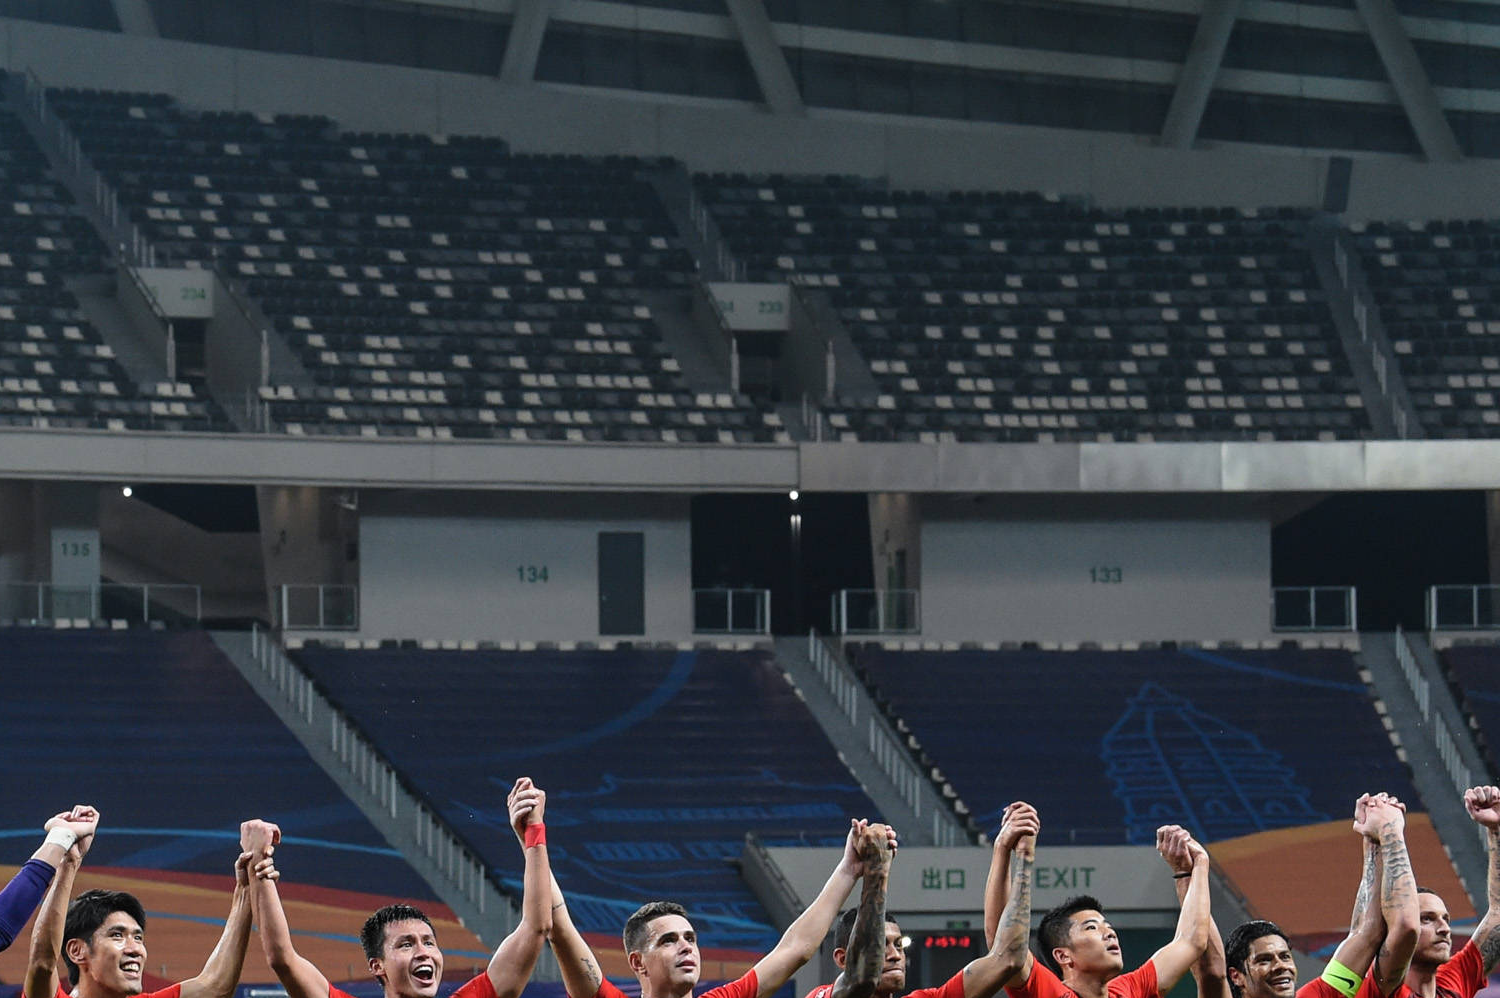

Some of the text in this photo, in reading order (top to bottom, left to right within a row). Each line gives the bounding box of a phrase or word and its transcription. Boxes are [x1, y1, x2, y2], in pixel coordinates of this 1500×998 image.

[61, 542, 90, 557] 135
[517, 565, 549, 583] 134
[1090, 567, 1122, 583] 133
[921, 867, 965, 890] 出口
[1034, 867, 1096, 889] EXIT
